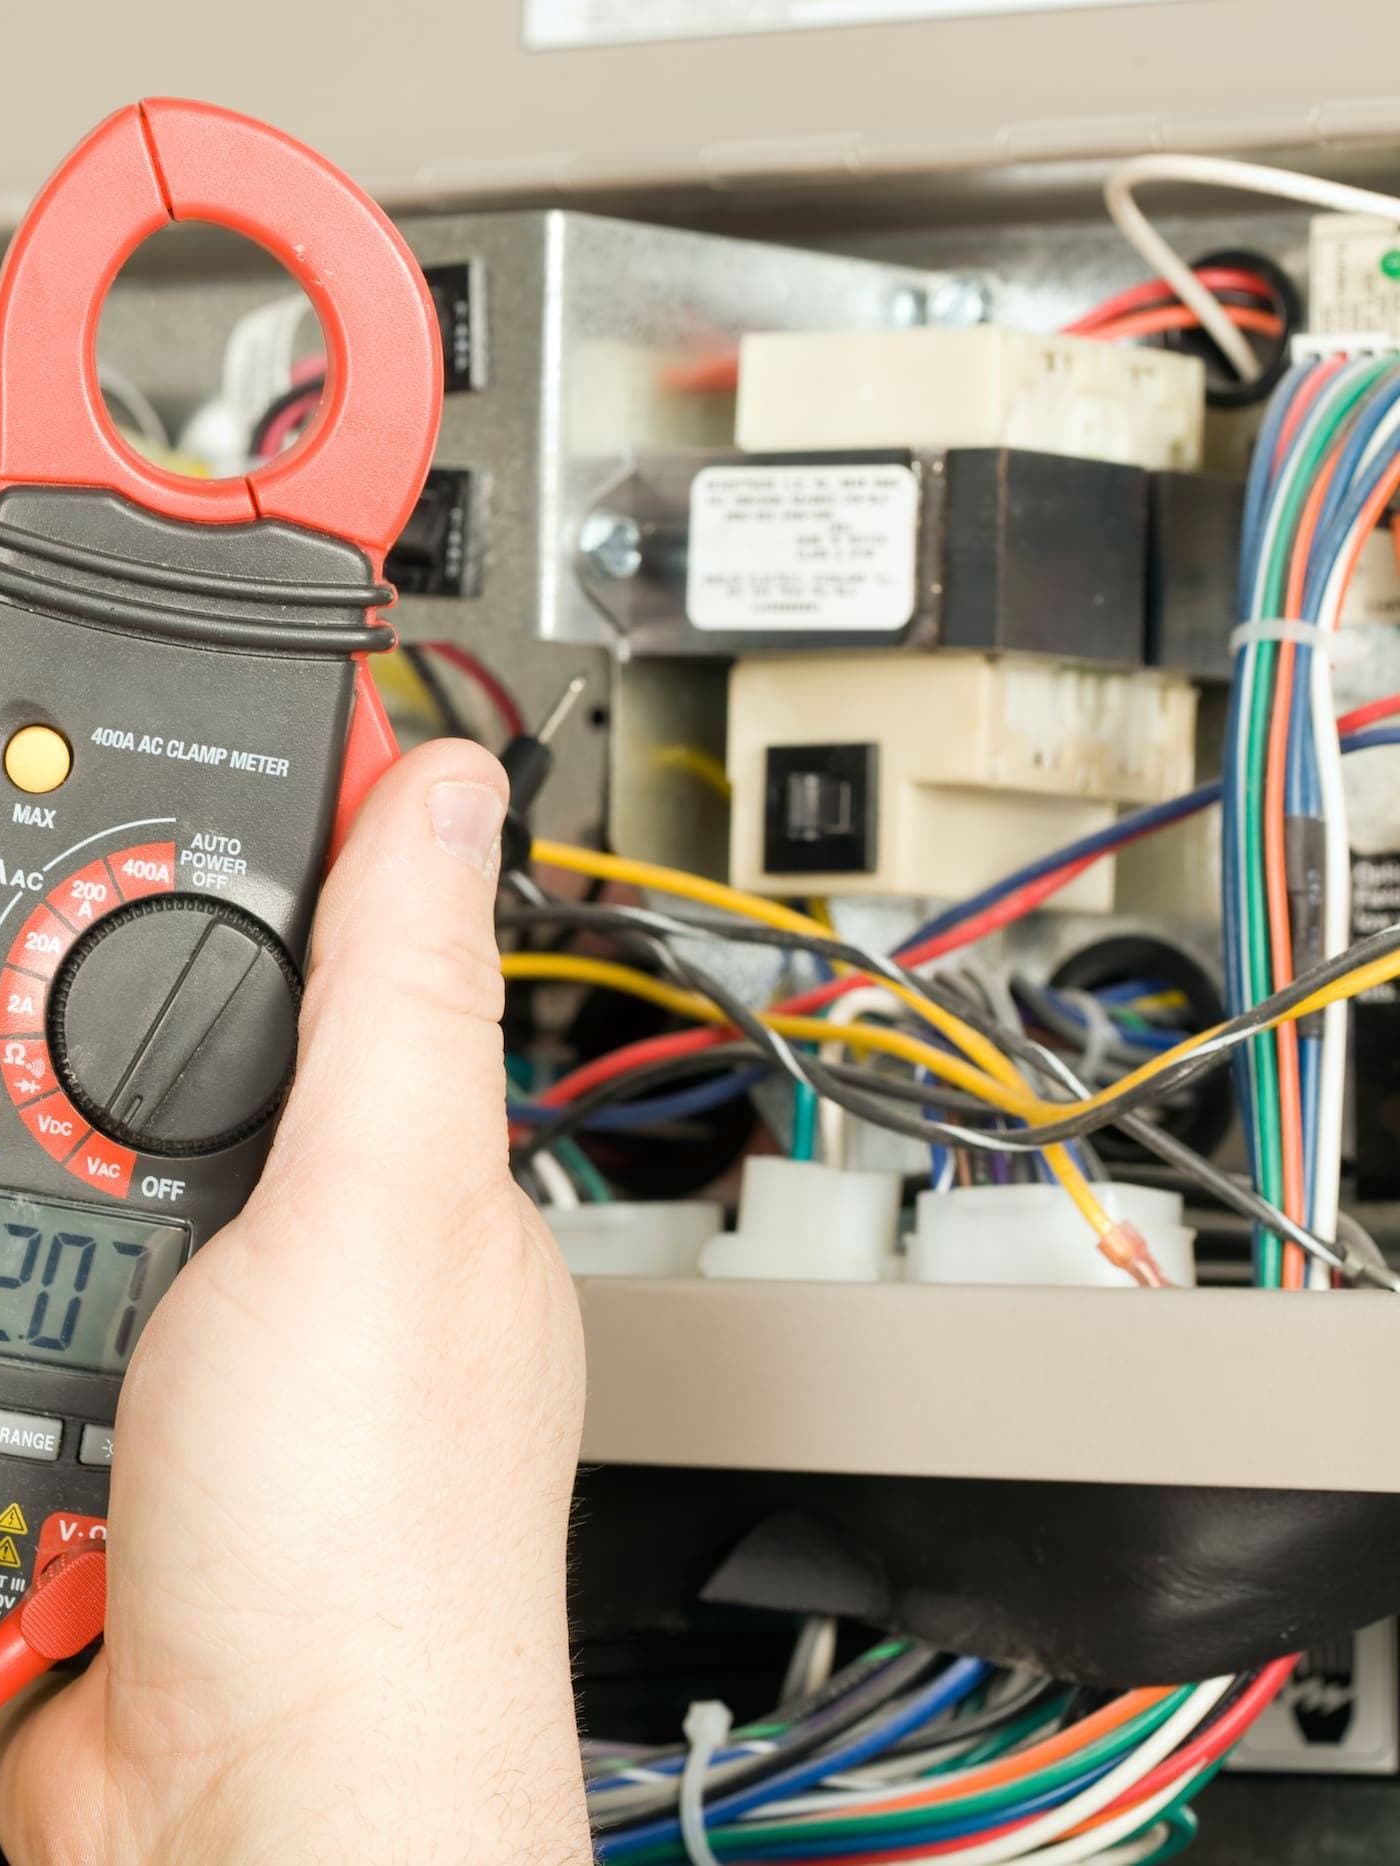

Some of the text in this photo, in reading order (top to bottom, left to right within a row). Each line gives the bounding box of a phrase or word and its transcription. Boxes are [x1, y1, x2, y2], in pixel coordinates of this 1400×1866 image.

[90, 727, 290, 778] 400A AC CLAMP METER
[12, 803, 57, 829] MAX
[190, 832, 242, 856] AUTO
[121, 858, 171, 884] 400A
[180, 850, 248, 876] POWER
[70, 879, 108, 901] 200
[192, 871, 228, 890] OFF
[77, 900, 94, 919] A
[24, 931, 62, 955] 20A
[6, 995, 34, 1015] 2A
[37, 1114, 73, 1137] VDC
[86, 1156, 121, 1178] VAC
[141, 1175, 186, 1201] OFF
[0, 1426, 56, 1452] RANGE
